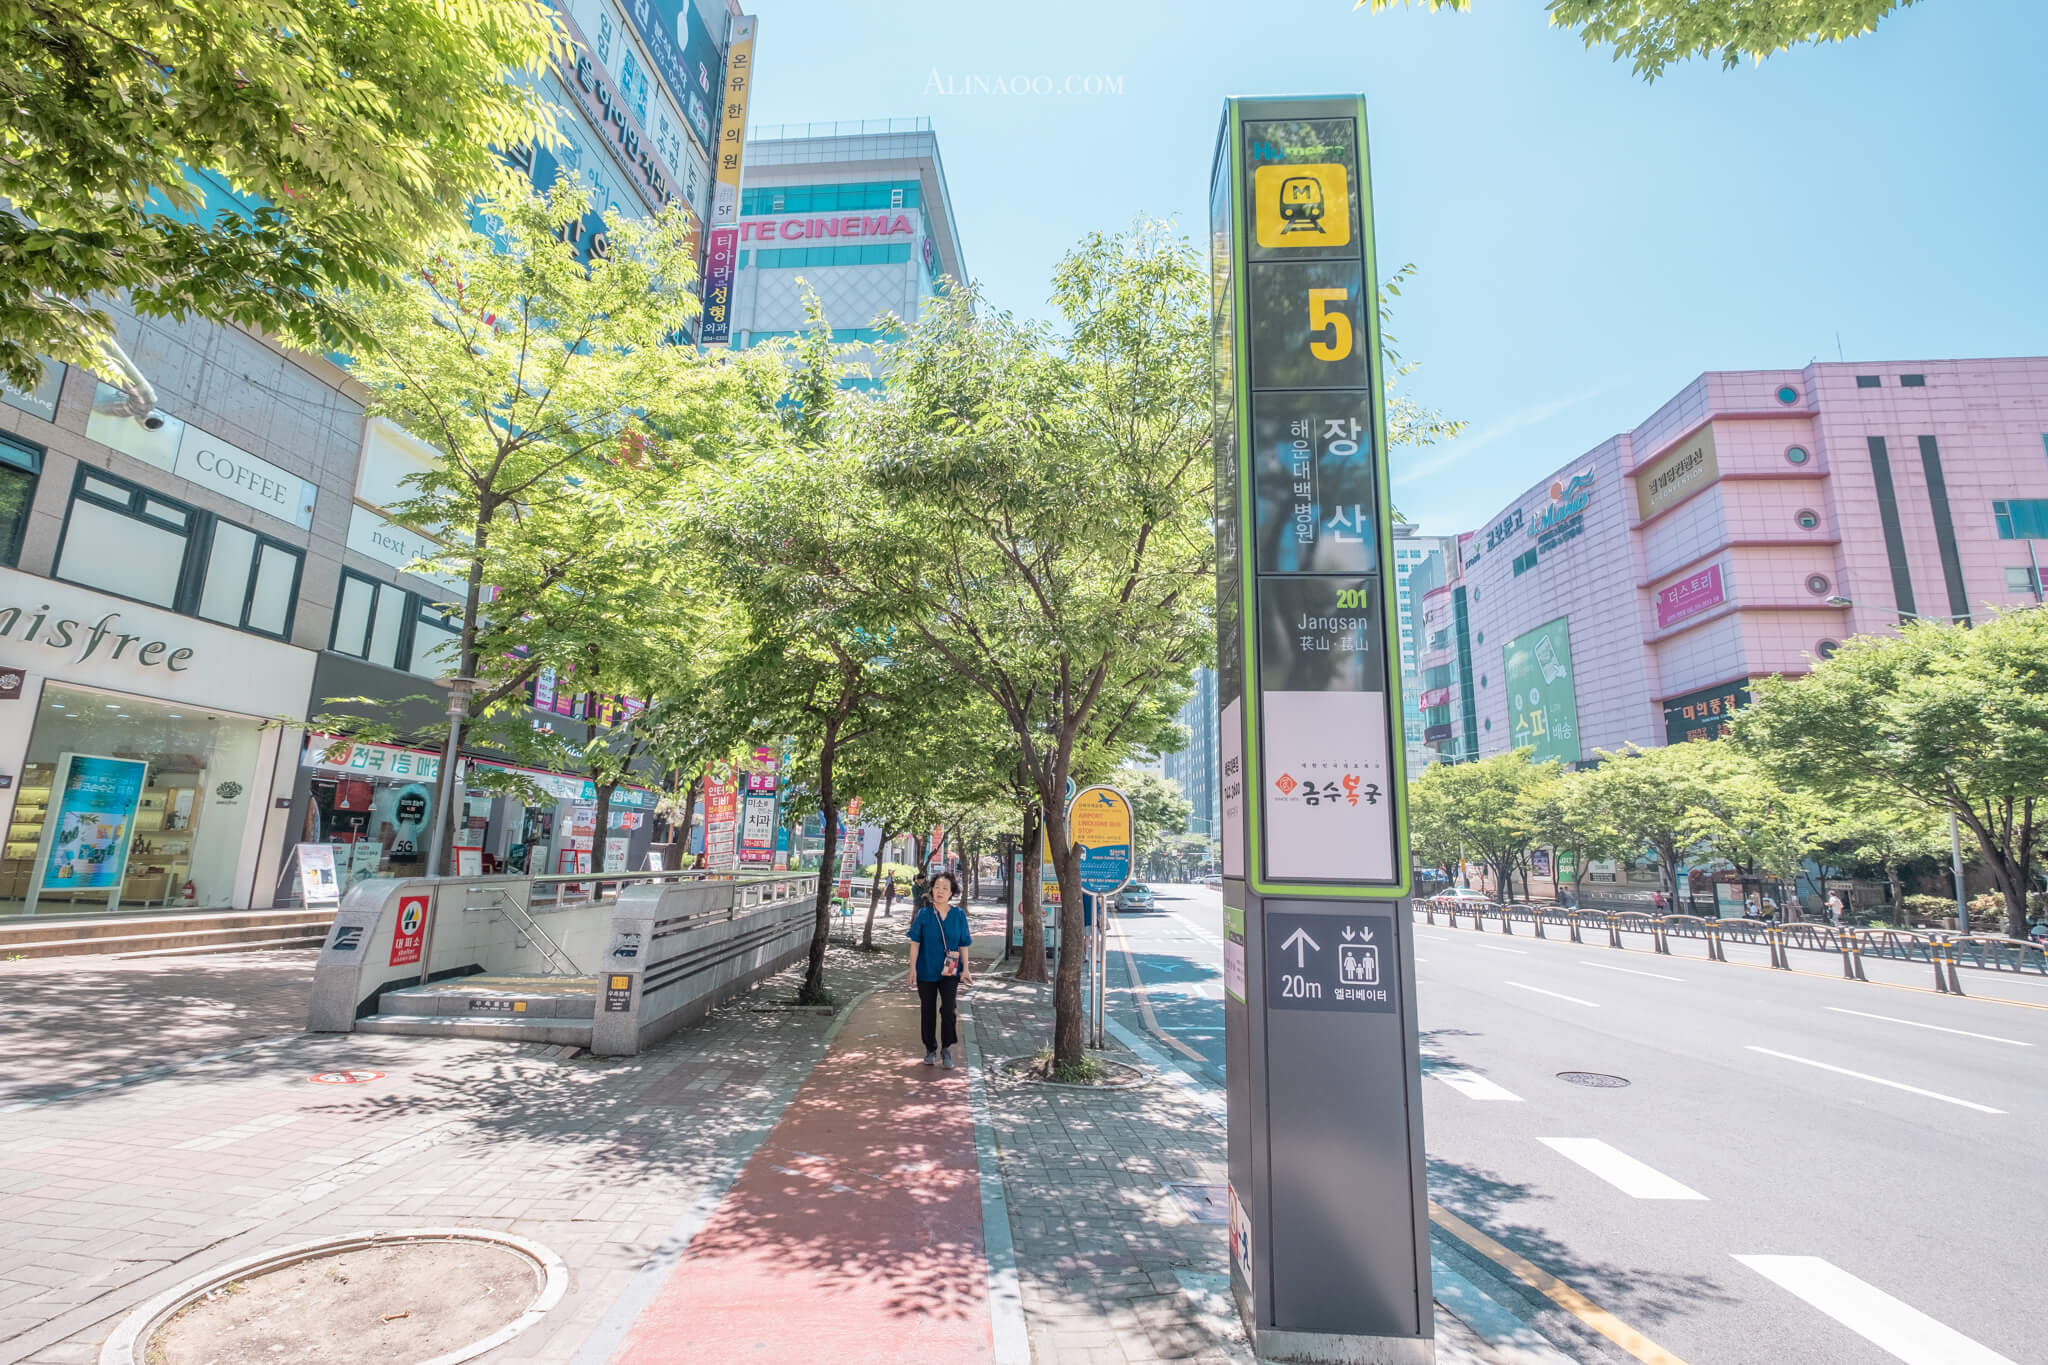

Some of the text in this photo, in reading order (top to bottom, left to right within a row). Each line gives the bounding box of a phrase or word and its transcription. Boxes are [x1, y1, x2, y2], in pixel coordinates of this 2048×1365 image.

[722, 53, 748, 170] 온유한의원
[1253, 142, 1345, 161] Humetro
[718, 204, 733, 216] 5F
[779, 214, 914, 241] CINEMA
[713, 233, 734, 282] 티아라
[1308, 288, 1353, 362] 5
[196, 449, 288, 505] COFFEE
[1290, 419, 1315, 545] 해운대백병원
[1323, 416, 1367, 544] 장산
[371, 530, 406, 556] next
[1485, 507, 1525, 553] 교보문고
[1336, 588, 1367, 609] 201
[1297, 612, 1368, 634] Jangsan
[351, 746, 385, 771] 전국
[390, 753, 411, 774] 1등
[1301, 773, 1383, 808] 금수복국
[749, 815, 770, 828] 치과
[1281, 974, 1322, 999] 20m
[1334, 988, 1387, 1002] 엘리베이터
